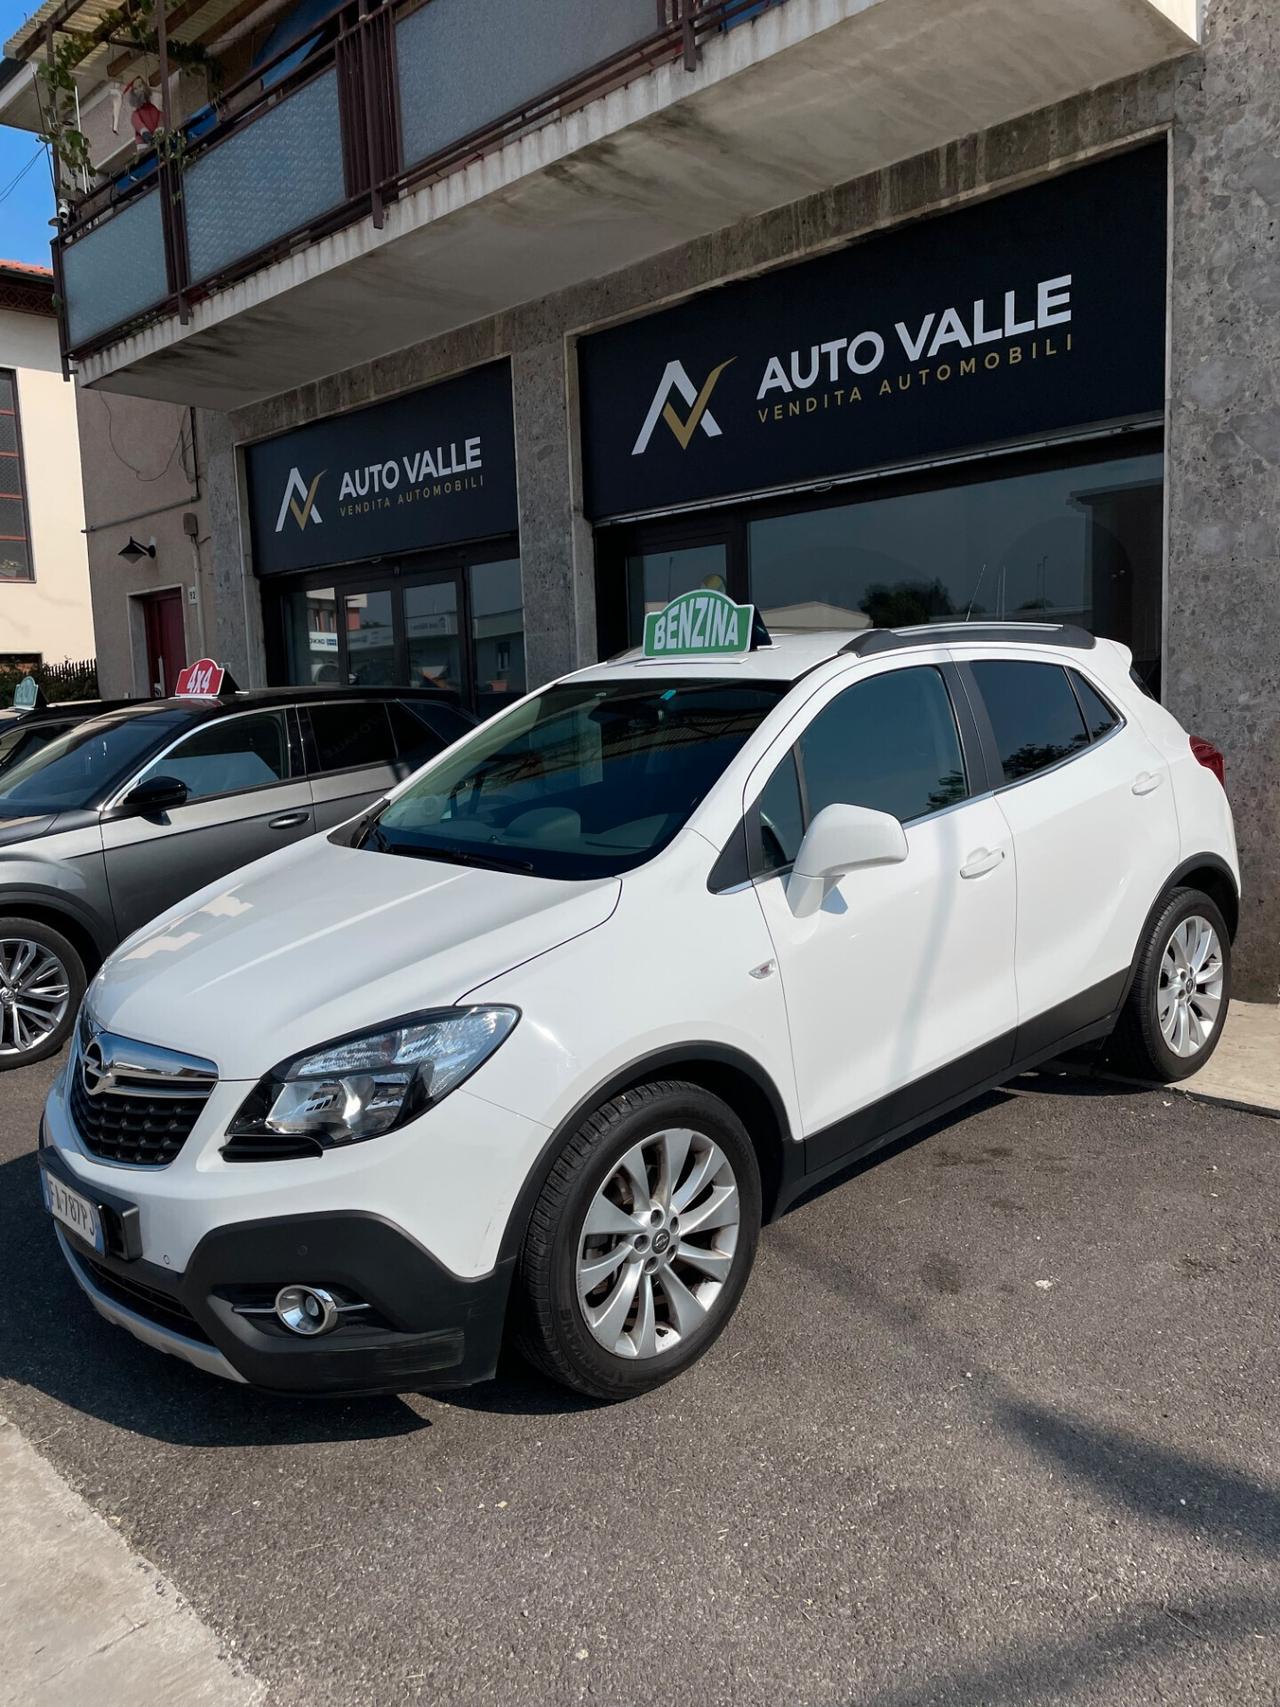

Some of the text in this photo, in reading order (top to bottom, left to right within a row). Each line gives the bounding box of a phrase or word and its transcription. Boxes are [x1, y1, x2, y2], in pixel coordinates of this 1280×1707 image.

[755, 273, 1073, 400] AUTO VALLE
[757, 333, 1073, 424] VENDITA AUTOMOBILI
[338, 436, 482, 501] AUTO VALLE
[339, 475, 484, 517] VENDITA AUTOMOBILI
[653, 597, 739, 650] BENZINA
